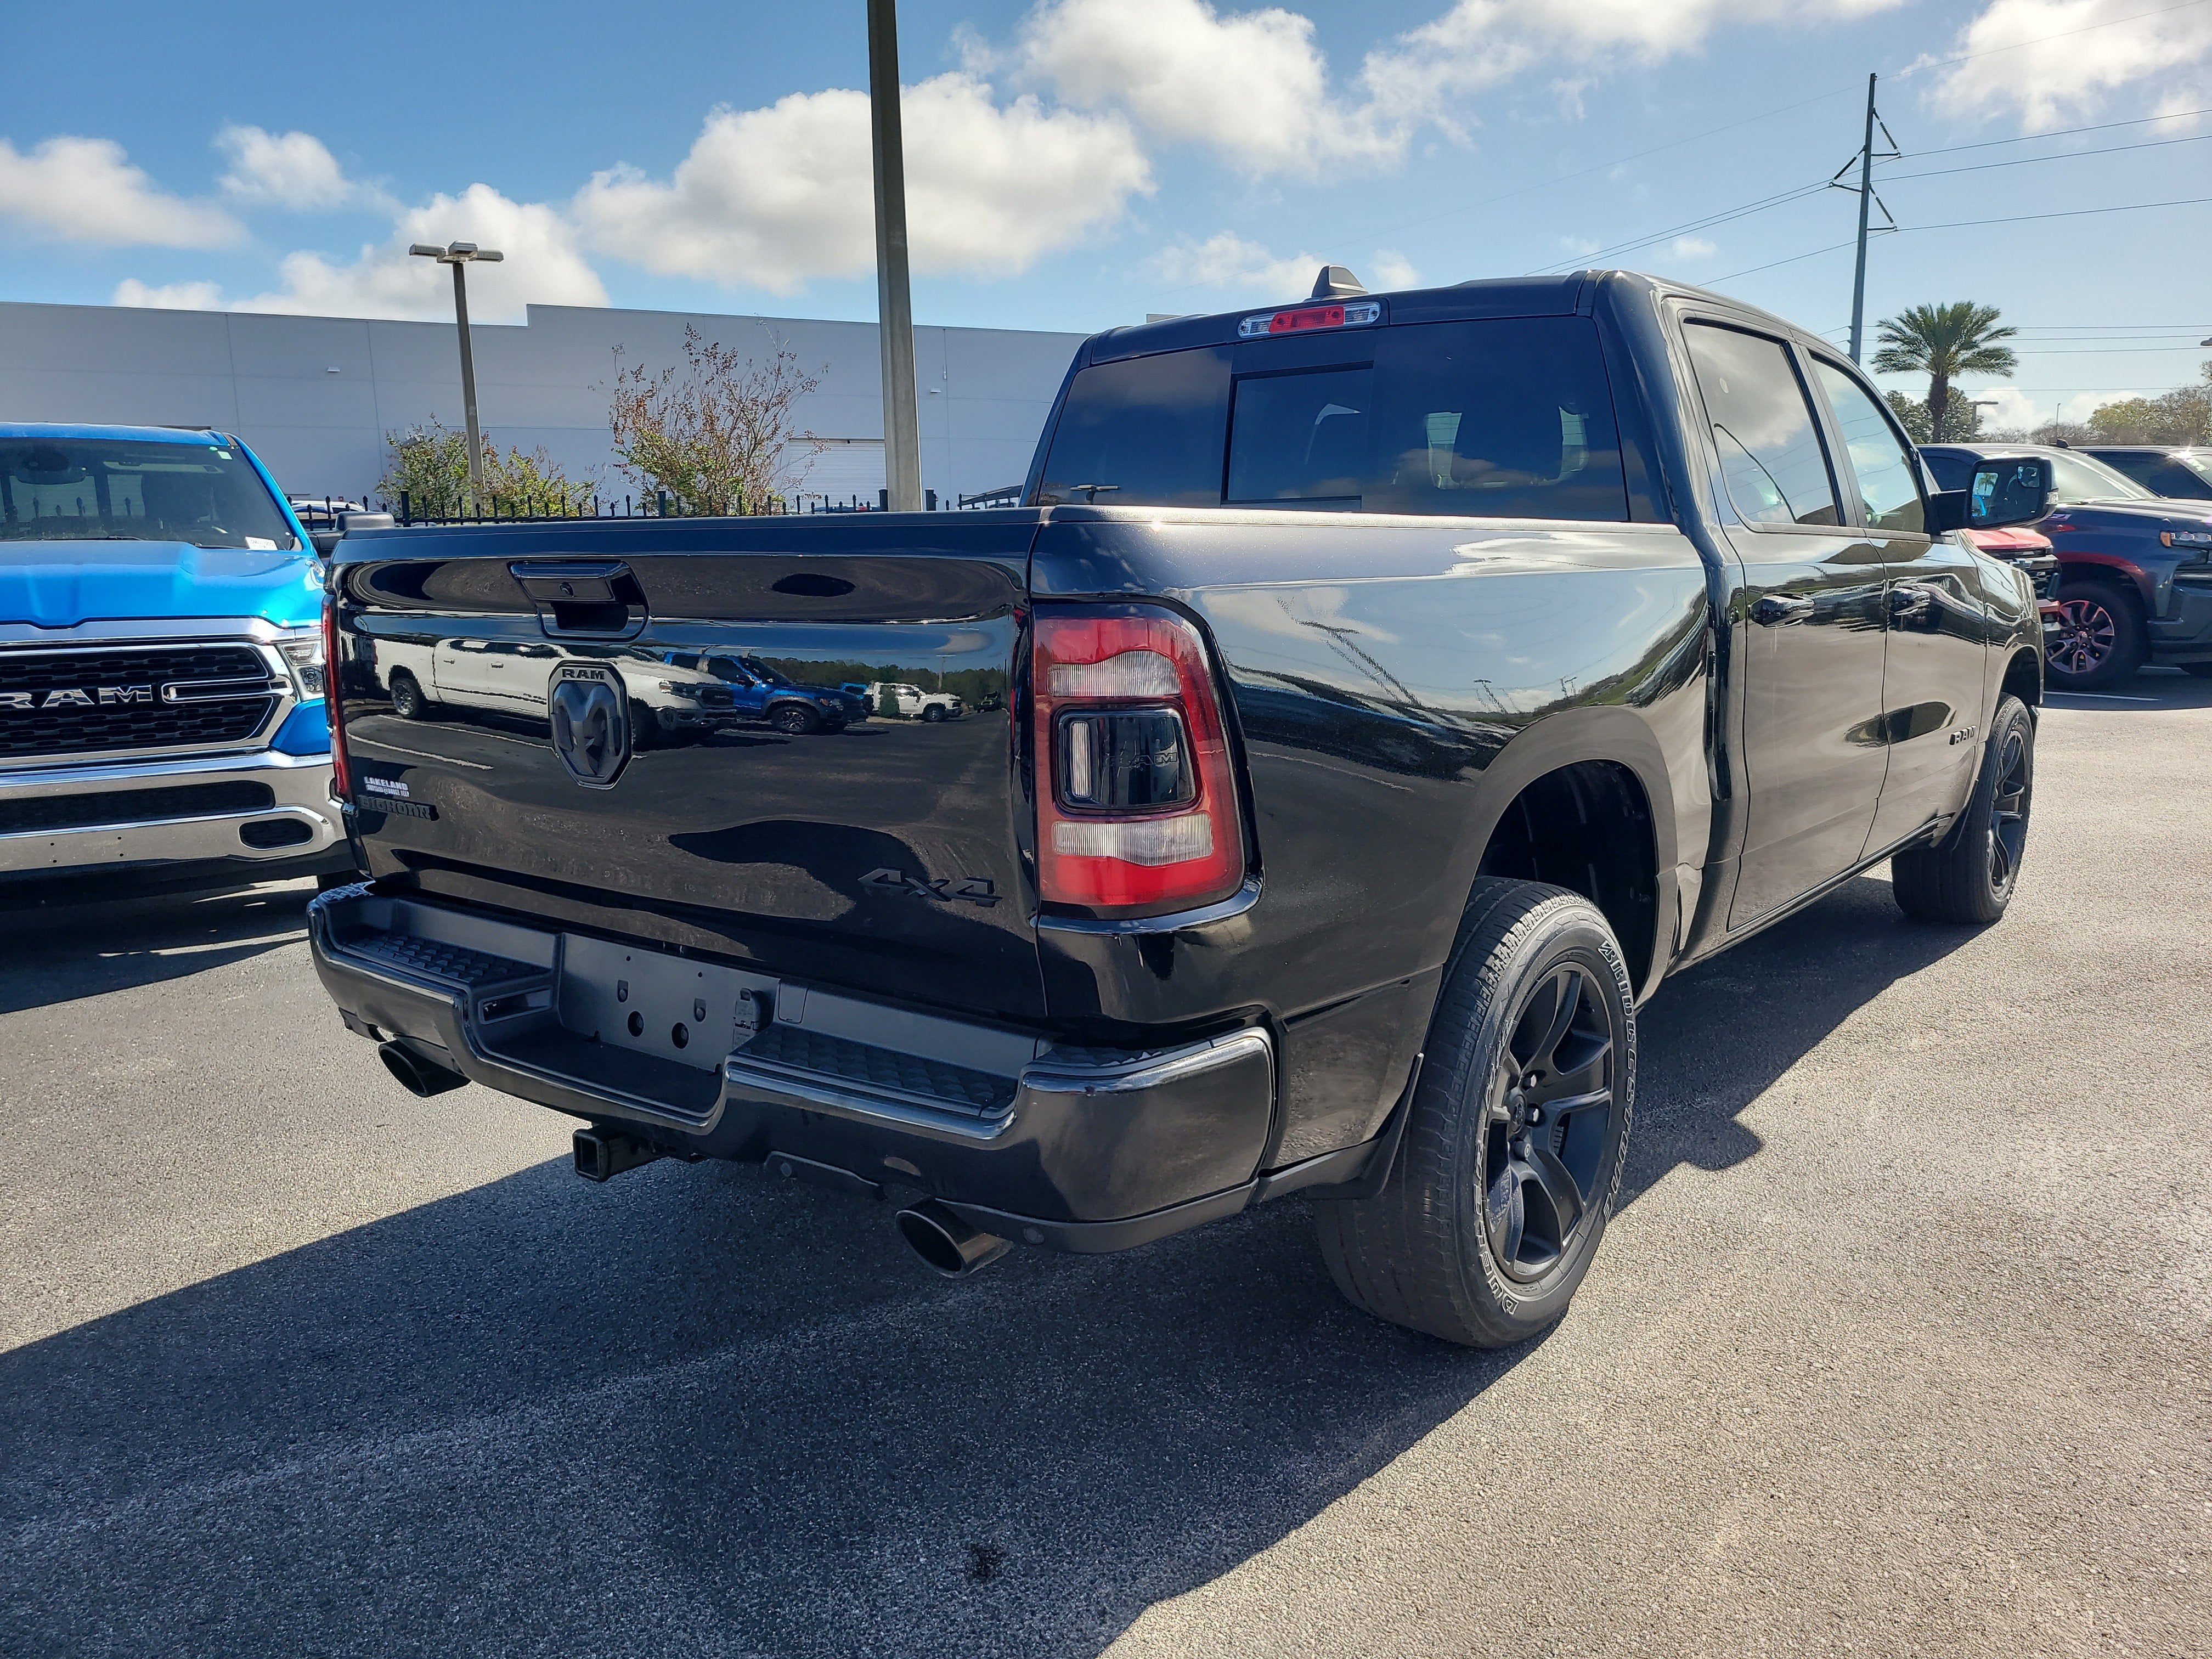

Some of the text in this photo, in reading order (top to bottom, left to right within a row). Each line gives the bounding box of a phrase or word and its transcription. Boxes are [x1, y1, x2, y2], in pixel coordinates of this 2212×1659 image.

[562, 669, 605, 680] RAM
[0, 685, 153, 708] RAM
[1949, 725, 1976, 745] RAM
[364, 776, 409, 791] LAKELAND
[1598, 940, 1637, 1224] BRIDGESTONE
[1473, 1139, 1519, 1315] DUELER
